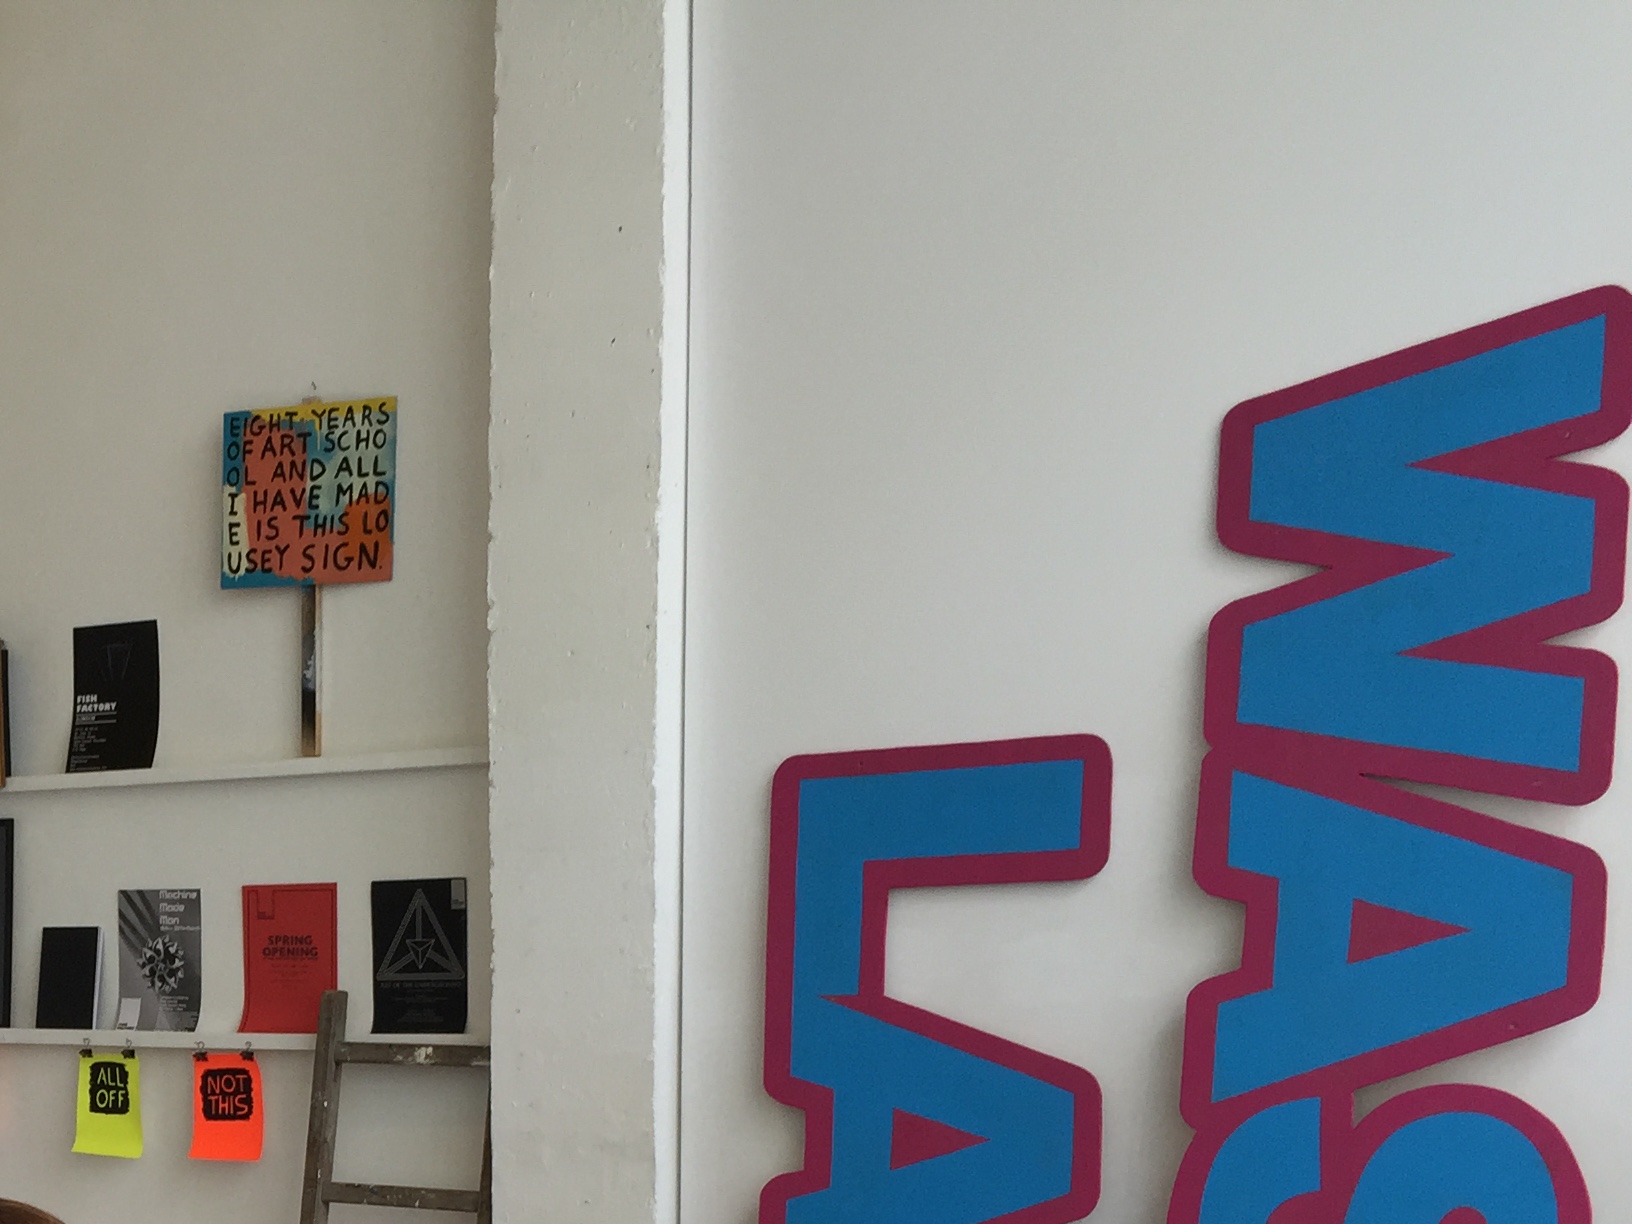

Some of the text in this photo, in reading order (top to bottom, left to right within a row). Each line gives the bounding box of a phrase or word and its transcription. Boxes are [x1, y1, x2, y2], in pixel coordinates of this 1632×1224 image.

[230, 402, 390, 437] EIGHT YEARS
[227, 428, 387, 461] OF ART SCHO
[227, 456, 387, 486] OL AND ALL
[253, 485, 322, 513] HAVE
[335, 481, 389, 507] MAD
[257, 516, 279, 541] IS
[292, 512, 350, 538] THIS
[362, 510, 389, 534] LO
[227, 541, 383, 574] USEY SIGN.
[77, 694, 97, 703] FISH
[77, 702, 117, 712] FACTORY
[160, 890, 197, 899] Machine
[160, 903, 184, 912] Made
[160, 916, 180, 924] Man
[268, 935, 312, 945] SPRING
[262, 947, 318, 957] OPENING
[97, 1067, 124, 1087] ALL
[207, 1075, 247, 1093] NOT
[96, 1089, 125, 1108] OFF
[208, 1094, 248, 1115] THIS
